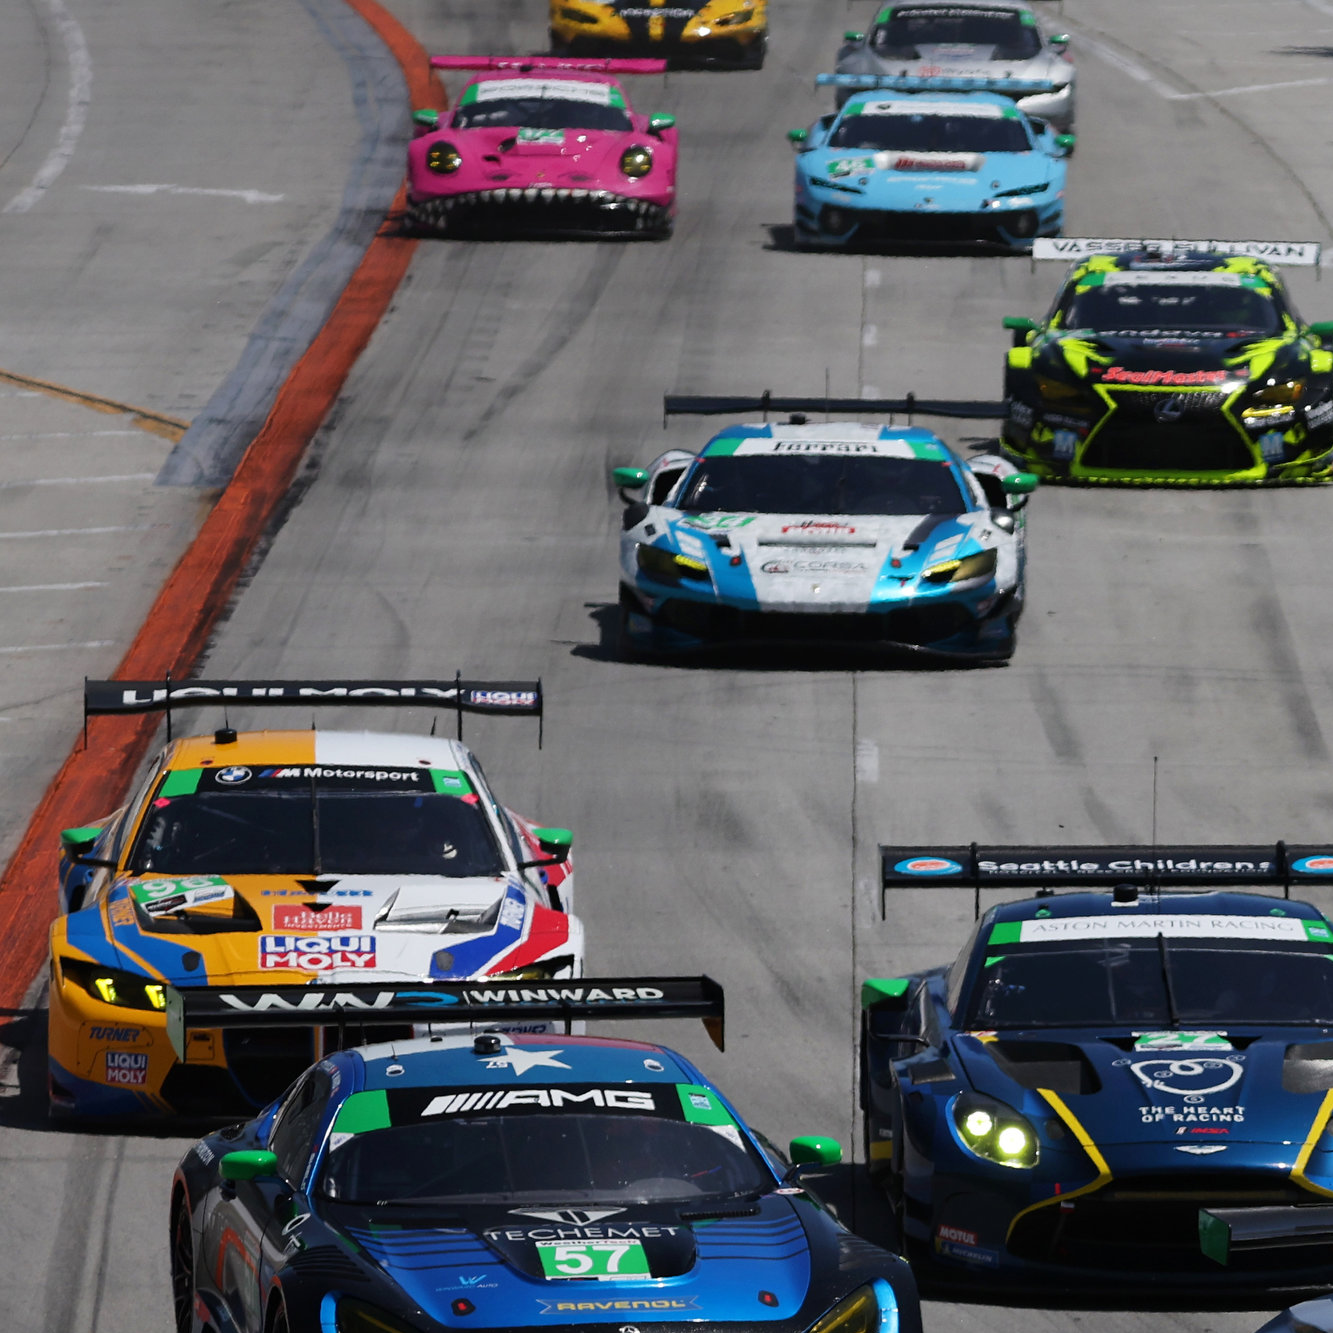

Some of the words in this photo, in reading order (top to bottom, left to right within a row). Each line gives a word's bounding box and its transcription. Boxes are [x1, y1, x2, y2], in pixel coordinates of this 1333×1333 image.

[1101, 367, 1227, 385] SealMaster
[774, 441, 878, 452] Ferrari
[304, 768, 419, 782] Motorsport
[978, 860, 1099, 871] Seattle
[1031, 923, 1108, 935] ASTON
[1117, 919, 1202, 932] MARTIN
[1210, 919, 1296, 933] RACING
[264, 937, 372, 952] LIQUI
[264, 953, 376, 969] MOLY
[470, 987, 665, 1001] WINWARD
[89, 1026, 141, 1042] TURNER
[107, 1054, 146, 1068] LIQUI
[107, 1069, 147, 1084] MOLY
[1139, 1106, 1175, 1115] THE
[1183, 1106, 1245, 1115] HEART
[1141, 1114, 1165, 1123] OF
[1173, 1113, 1245, 1122] RACING
[487, 1226, 679, 1241] TECHEMET
[940, 1226, 975, 1245] MOTUL
[554, 1244, 631, 1274] 57
[556, 1301, 686, 1311] RAVENOL
